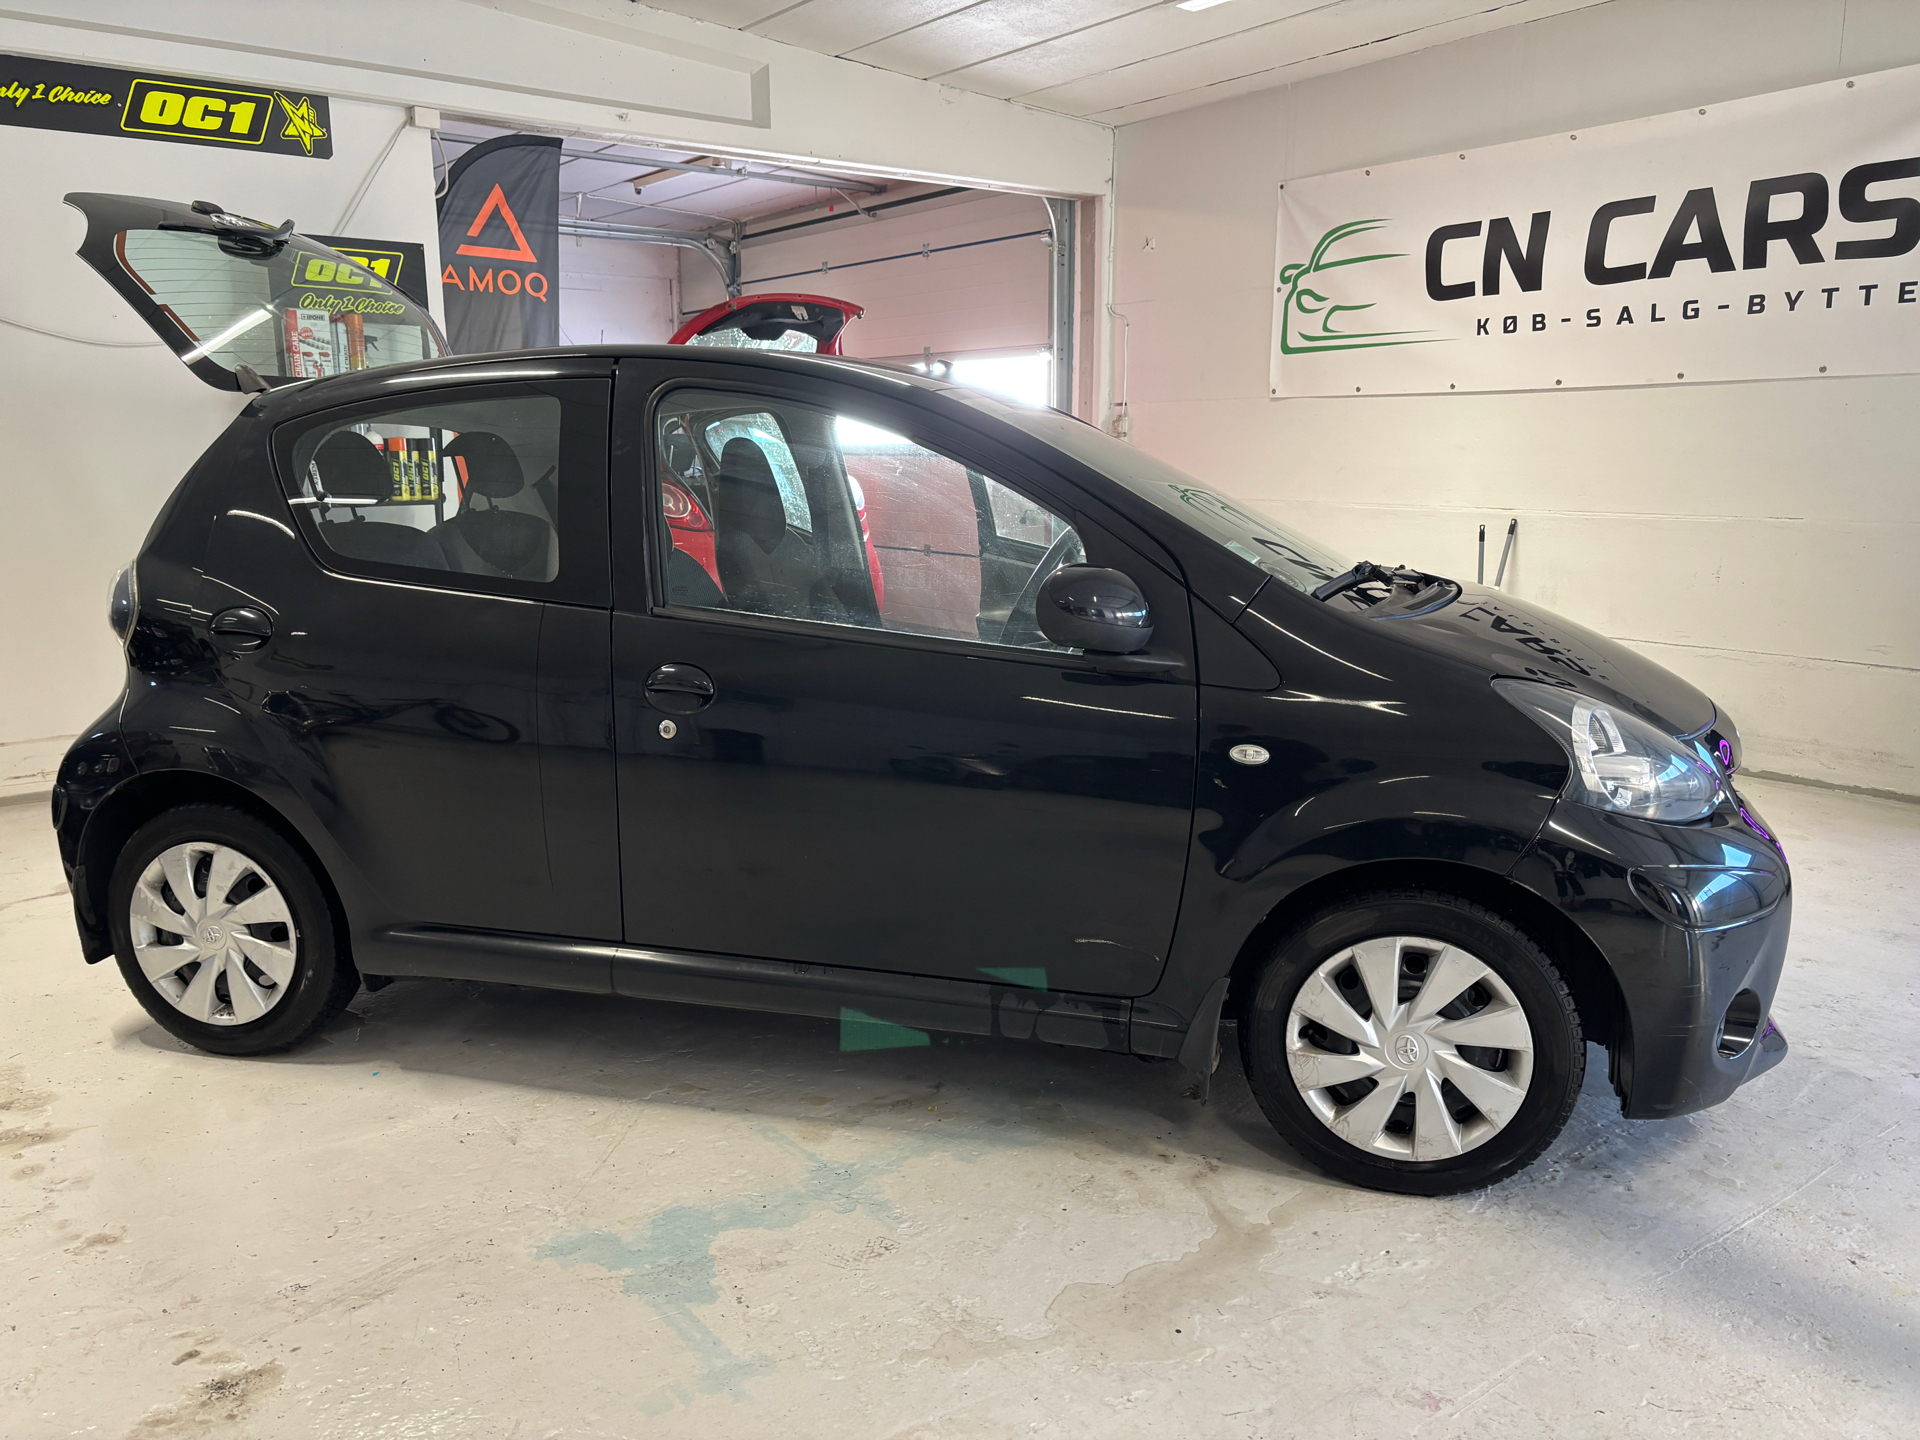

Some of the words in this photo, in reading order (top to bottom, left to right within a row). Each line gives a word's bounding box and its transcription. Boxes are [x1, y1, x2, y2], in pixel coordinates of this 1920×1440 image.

[31, 83, 46, 100] 1
[48, 85, 113, 105] Choice
[139, 90, 257, 135] OC1
[1425, 210, 1551, 302] CN
[1583, 156, 1920, 286] CARS
[441, 264, 549, 303] AMOQ
[299, 293, 341, 315] Only
[341, 296, 354, 311] 1
[354, 298, 405, 315] Choice
[291, 331, 300, 352] CARE
[293, 353, 302, 378] CHAIN
[421, 461, 429, 481] OC1
